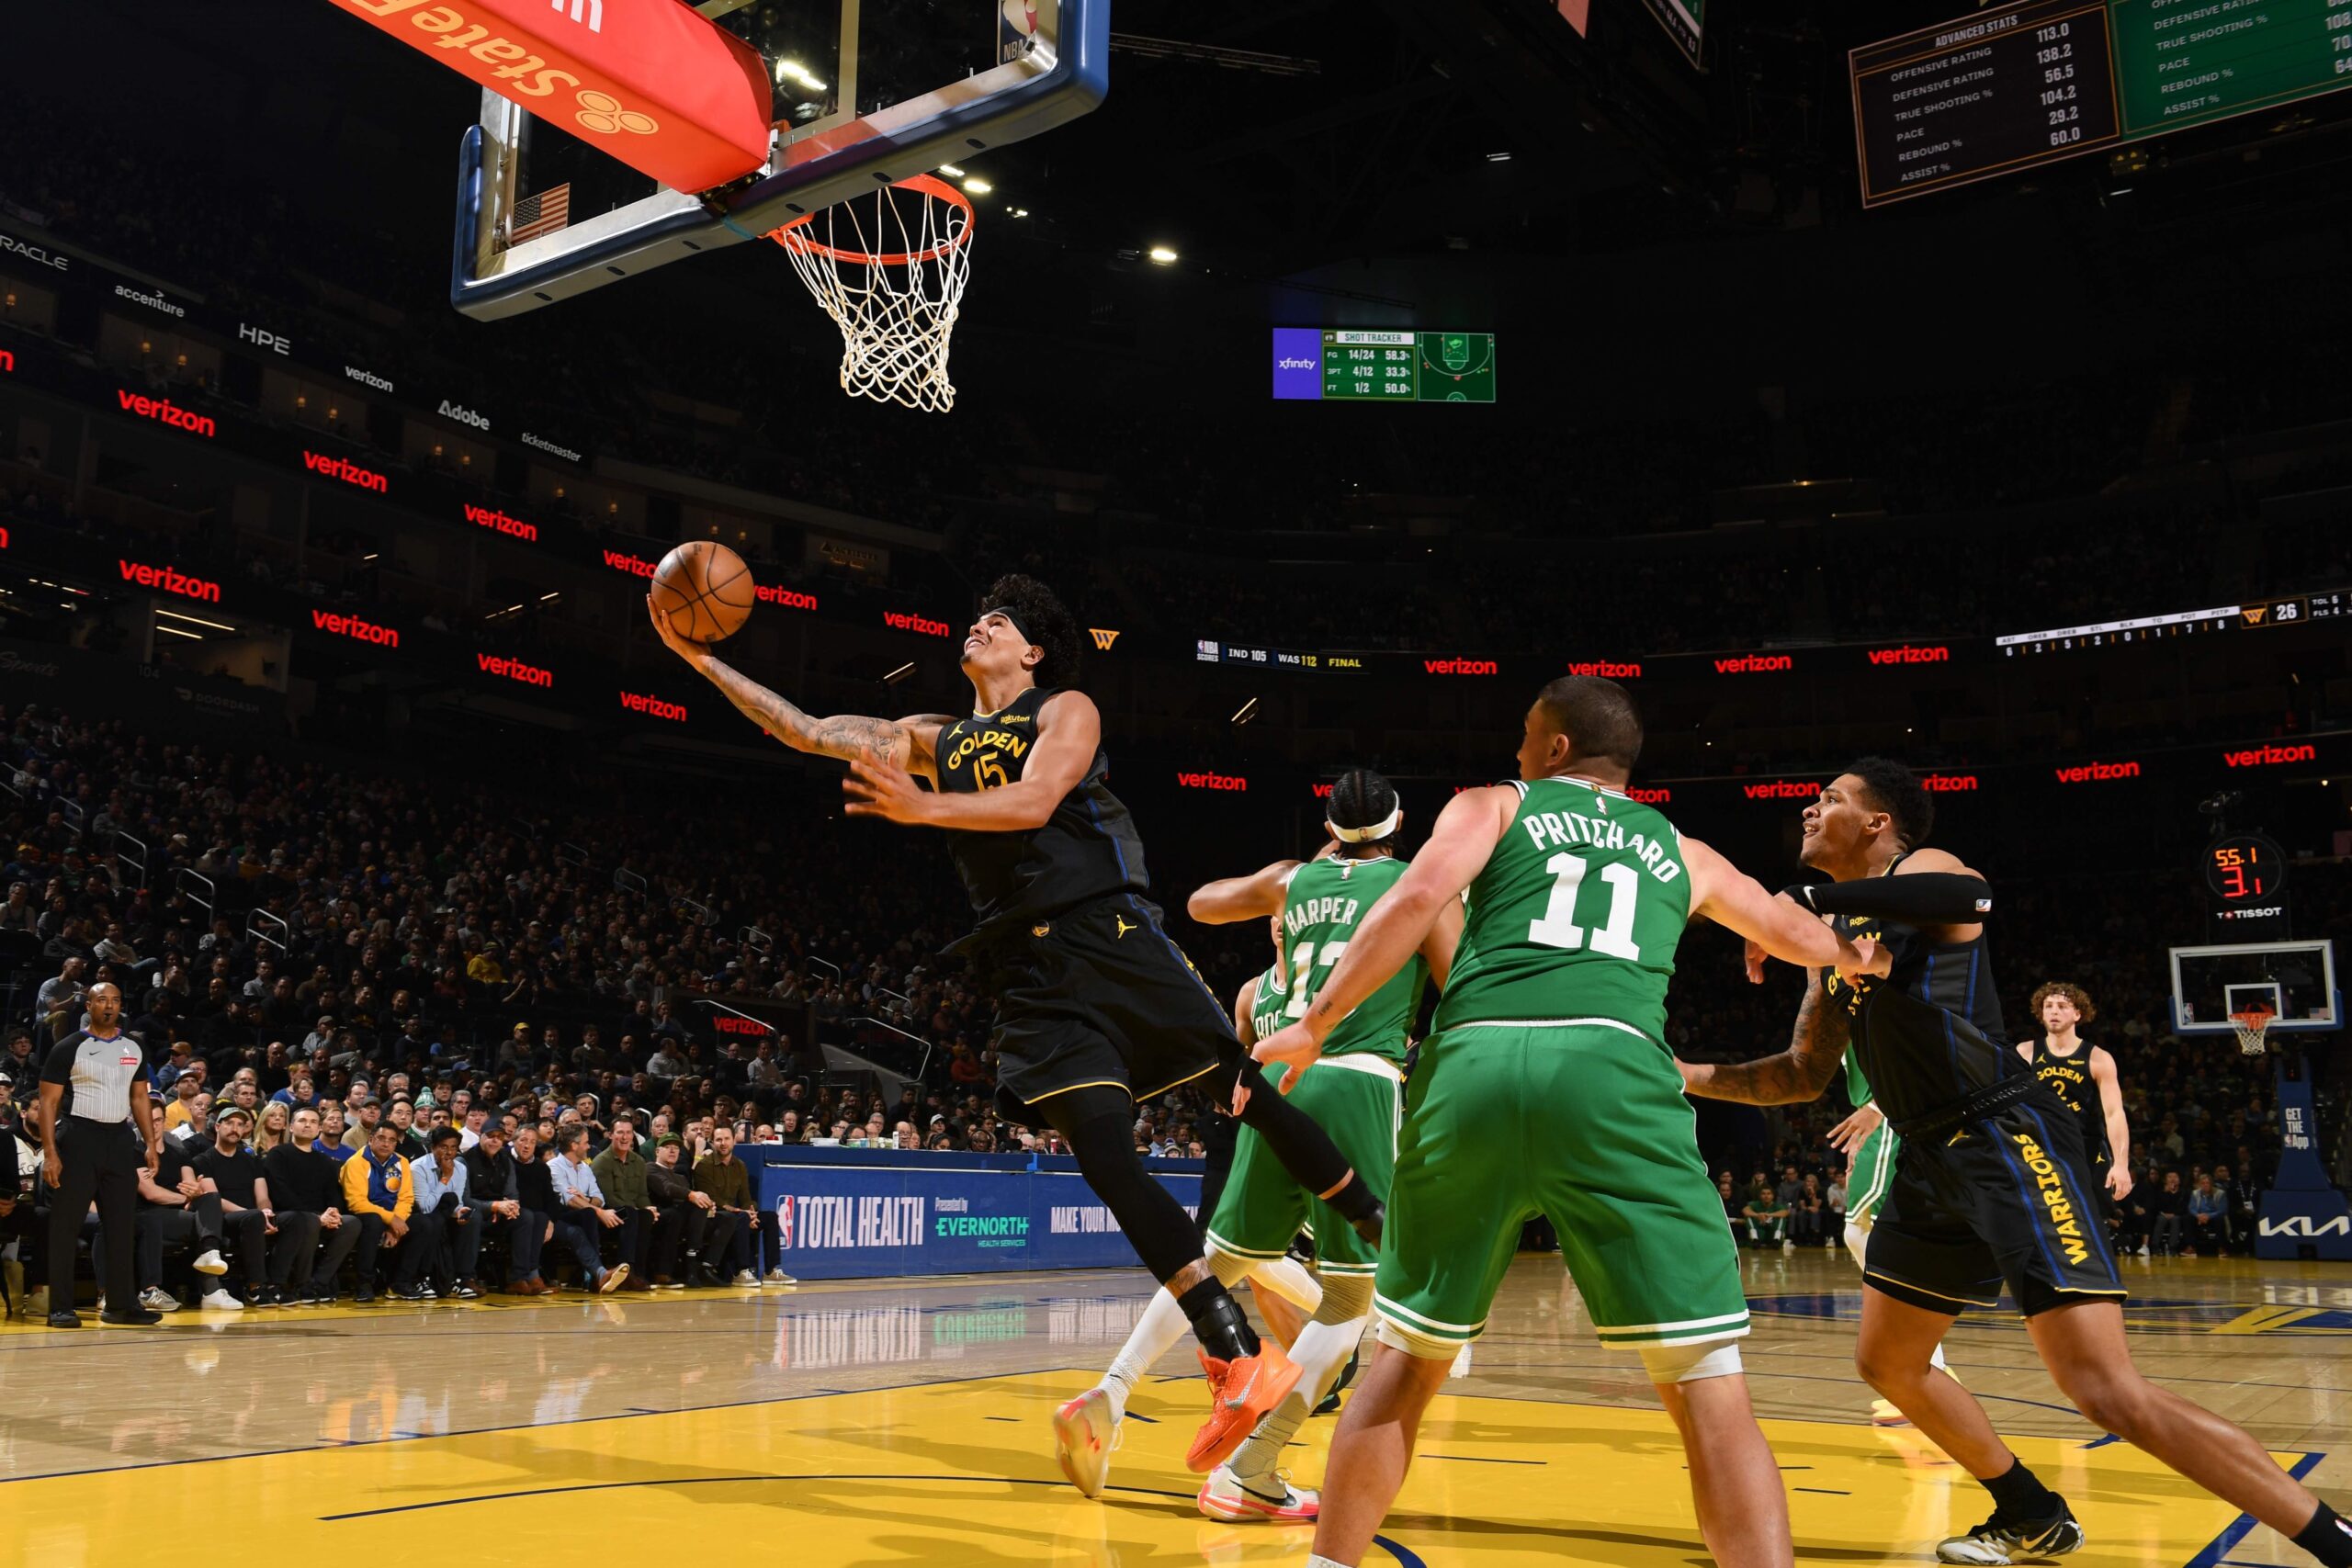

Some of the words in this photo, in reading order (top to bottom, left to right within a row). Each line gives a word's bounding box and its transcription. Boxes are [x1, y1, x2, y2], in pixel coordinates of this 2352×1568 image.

[2154, 5, 2221, 30] DEFENSIVE
[1935, 24, 1985, 48] ADVANCED
[1986, 15, 2019, 34] STATS
[2155, 36, 2187, 51] TRUE
[2189, 18, 2254, 42] SHOOTING
[2256, 15, 2268, 24] %
[410, 6, 582, 97] State
[1003, 39, 1024, 62] NBA
[1891, 58, 1950, 83] OFFENSIVE
[1951, 47, 1993, 64] RATING
[2036, 22, 2070, 43] 113.0
[1893, 79, 1951, 102] DEFENSIVE
[1952, 67, 1995, 85] RATING
[2036, 43, 2073, 64] 138.2
[2158, 57, 2190, 73] PACE
[1894, 107, 1922, 122] TRUE
[1924, 92, 1981, 115] SHOOTING
[2044, 64, 2075, 84] 56.5
[2161, 73, 2220, 94] REBOUND
[2222, 68, 2233, 78] %
[1896, 127, 1925, 141] PACE
[2040, 85, 2076, 106] 104.2
[2164, 97, 2206, 116] ASSIST
[2208, 93, 2221, 104] %
[1898, 141, 1951, 163] REBOUND
[2048, 106, 2079, 126] 29.2
[1900, 164, 1939, 182] ASSIST
[2050, 127, 2081, 147] 60.0
[0, 234, 69, 271] RACLE
[115, 285, 185, 318] accenture
[239, 322, 290, 355] HPE
[1344, 333, 1365, 343] SHOT
[1367, 333, 1402, 344] TRACKER
[1278, 357, 1316, 370] xfinity
[1327, 351, 1339, 359] FG
[1348, 349, 1375, 361] 14/24
[345, 366, 393, 393] verizon
[1327, 367, 1342, 376] 3PT
[1352, 365, 1374, 378] 4/12
[1354, 382, 1370, 394] 1/2
[118, 389, 216, 437] verizon
[437, 400, 490, 431] Adobe
[521, 432, 582, 462] ticketmaster
[303, 450, 388, 493] verizon
[464, 503, 538, 542] verizon
[603, 549, 657, 580] verizo
[119, 559, 220, 603] verizon
[2276, 603, 2298, 621] 26
[2333, 606, 2340, 615] 4
[312, 609, 399, 648] verizon
[883, 611, 951, 637] verizon
[1204, 640, 1219, 655] NBA
[2035, 643, 2042, 653] 2
[2064, 638, 2071, 649] 5
[2094, 635, 2101, 646] 2
[2155, 627, 2162, 637] 1
[2186, 624, 2192, 634] 7
[1196, 653, 1219, 662] SCORES
[1228, 649, 1249, 659] IND
[1250, 650, 1267, 662] 105
[1278, 654, 1300, 664] WAS
[1301, 655, 1317, 668] 112
[1329, 658, 1362, 668] FINAL
[1424, 657, 1498, 675] verizon
[1713, 653, 1792, 673] verizon
[1868, 645, 1949, 665] verizon
[477, 653, 553, 688] verizon
[1567, 660, 1642, 679] verizon
[620, 691, 687, 722] verizon
[1000, 714, 1031, 725] Rakuten
[947, 730, 1027, 770] GOLDEN
[2223, 744, 2316, 768] verizon
[974, 750, 1008, 792] 15
[1177, 771, 1247, 792] verizon
[1922, 773, 1978, 792] rizon
[2055, 761, 2140, 784] verizon
[1625, 785, 1671, 803] izon
[1744, 780, 1821, 798] verizon
[1521, 811, 1680, 883] PRITCHARD
[2215, 847, 2257, 866] 55.1
[1284, 897, 1359, 936] HARPER
[1528, 852, 1641, 962] 11
[2233, 907, 2282, 919] TISSOT
[2285, 1108, 2301, 1121] GET
[2286, 1121, 2304, 1134] THE
[2292, 1134, 2310, 1149] App
[935, 1197, 961, 1212] Presented
[962, 1197, 968, 1213] by
[2013, 1134, 2088, 1265] WARRIORS
[797, 1196, 854, 1248] TOTAL
[857, 1196, 925, 1247] HEALTH
[935, 1216, 1029, 1236] EVERNORTH
[1050, 1206, 1079, 1234] MAKE
[1080, 1206, 1105, 1233] YOUR
[2258, 1215, 2351, 1236] KIA
[978, 1239, 1000, 1247] HEALTH
[1000, 1239, 1026, 1247] SERVICES
